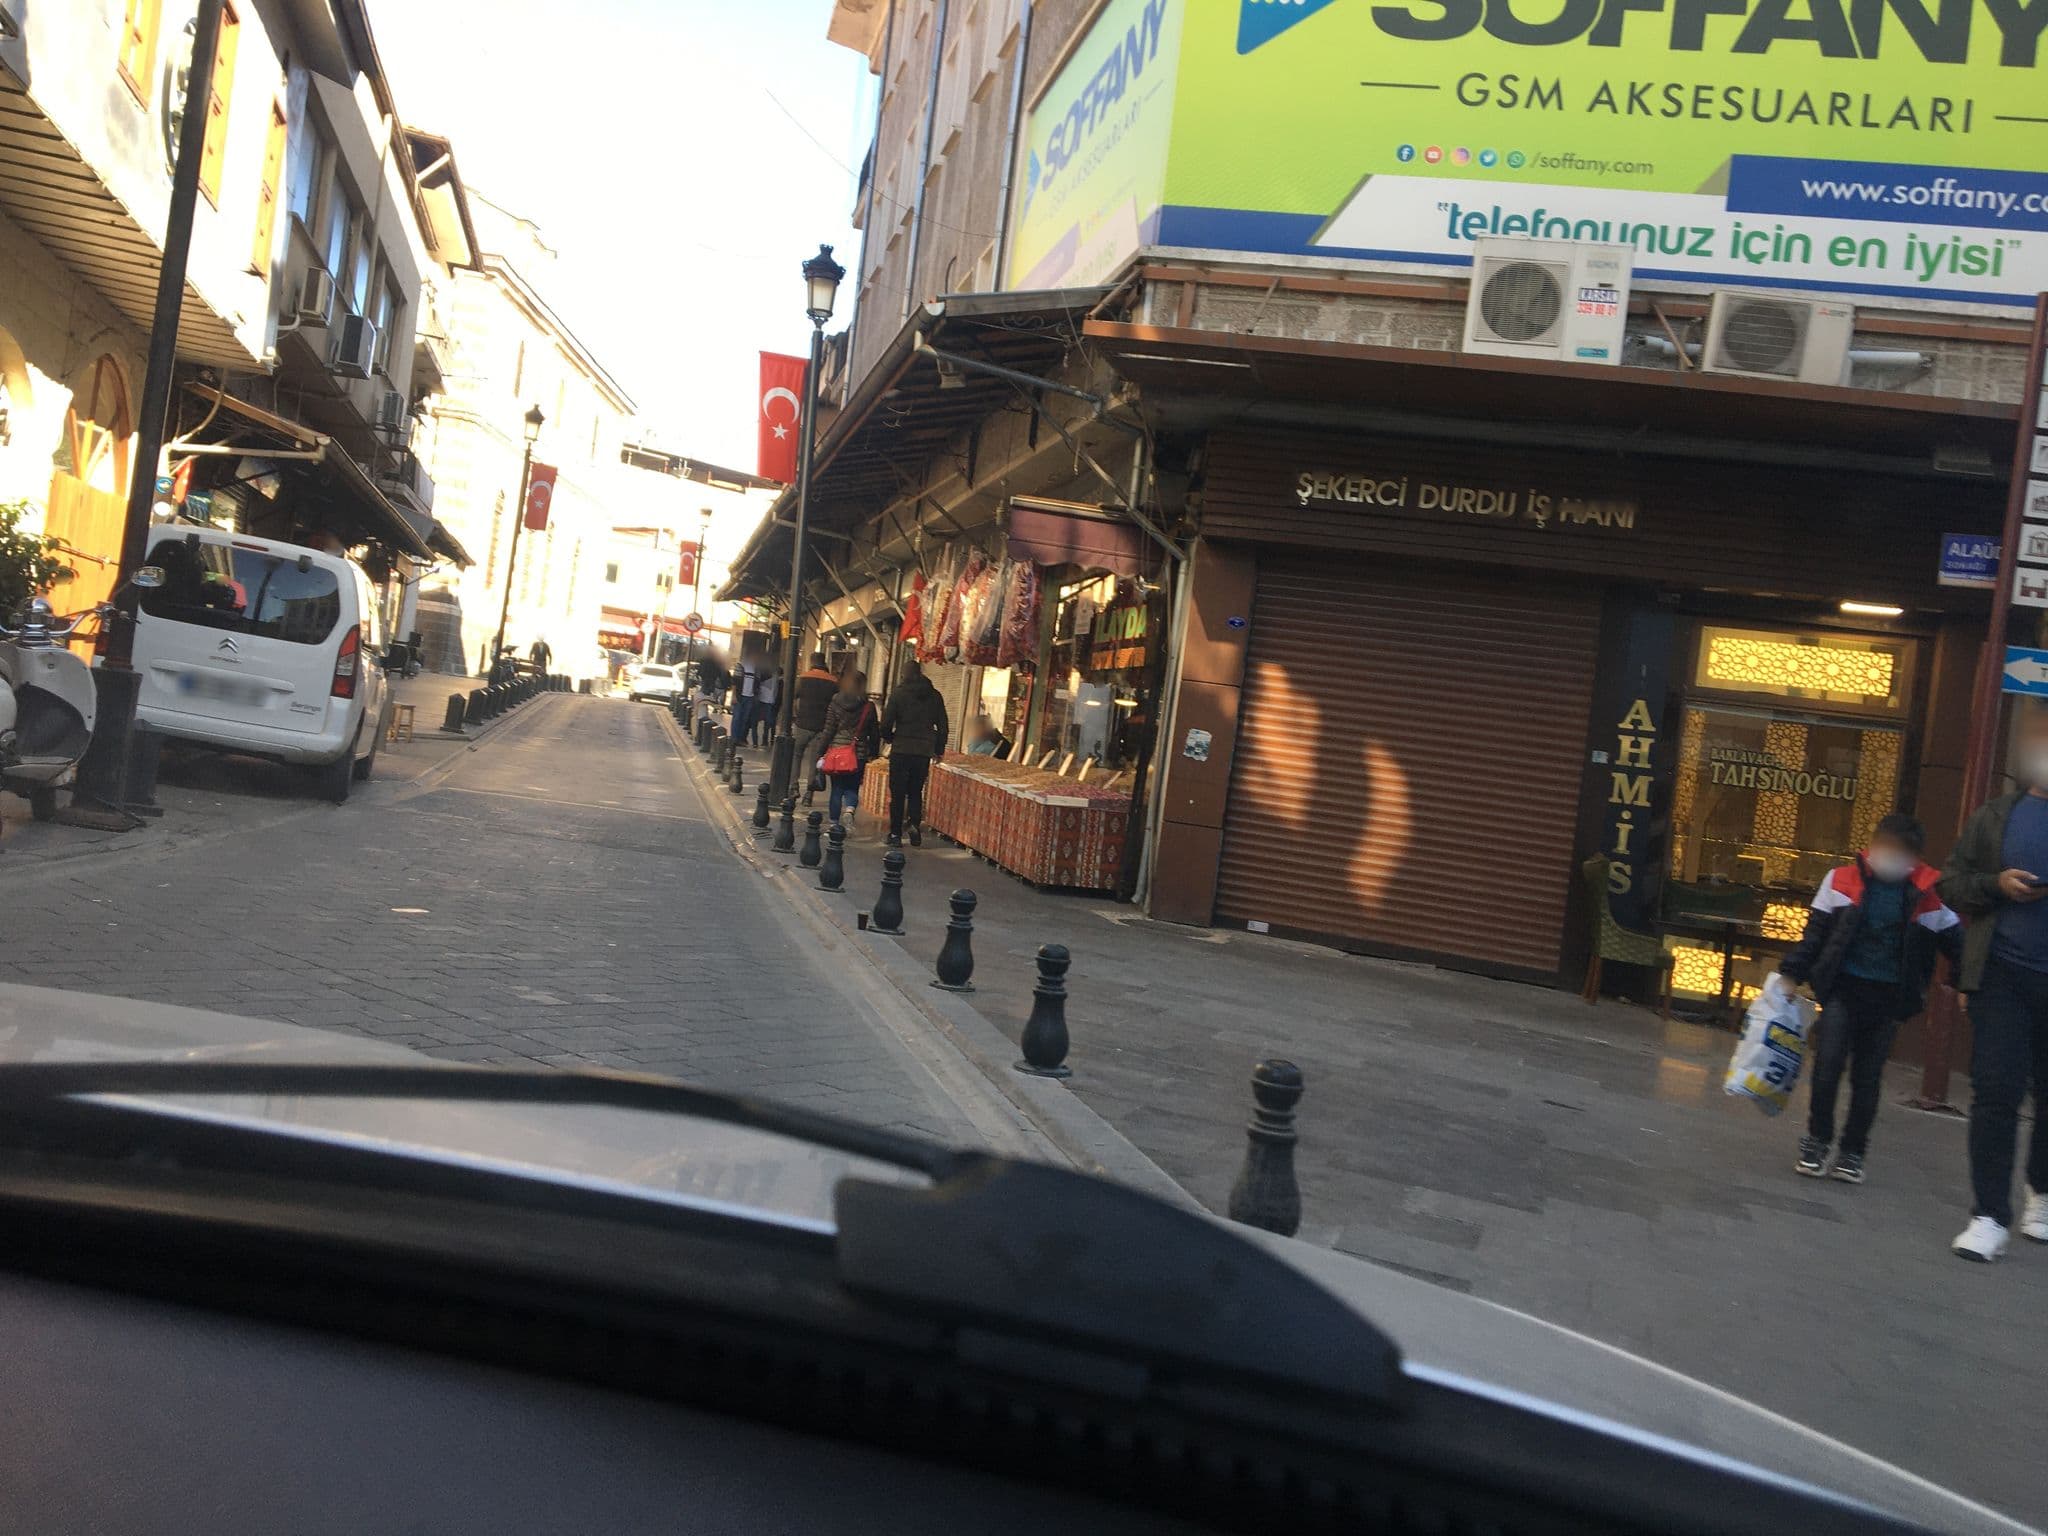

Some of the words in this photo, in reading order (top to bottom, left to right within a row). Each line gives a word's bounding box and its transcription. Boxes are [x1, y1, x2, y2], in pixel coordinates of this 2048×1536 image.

[1042, 0, 1166, 191] SOFFANY
[1457, 72, 1564, 110] GSM
[1586, 80, 1973, 133] AKSESUARLARI
[1530, 153, 1654, 177] /soffany.com
[1730, 222, 1812, 265] için
[1827, 234, 1887, 269] en
[1297, 473, 1408, 506] ŞEKERCİ
[1418, 484, 1517, 516] DURDU
